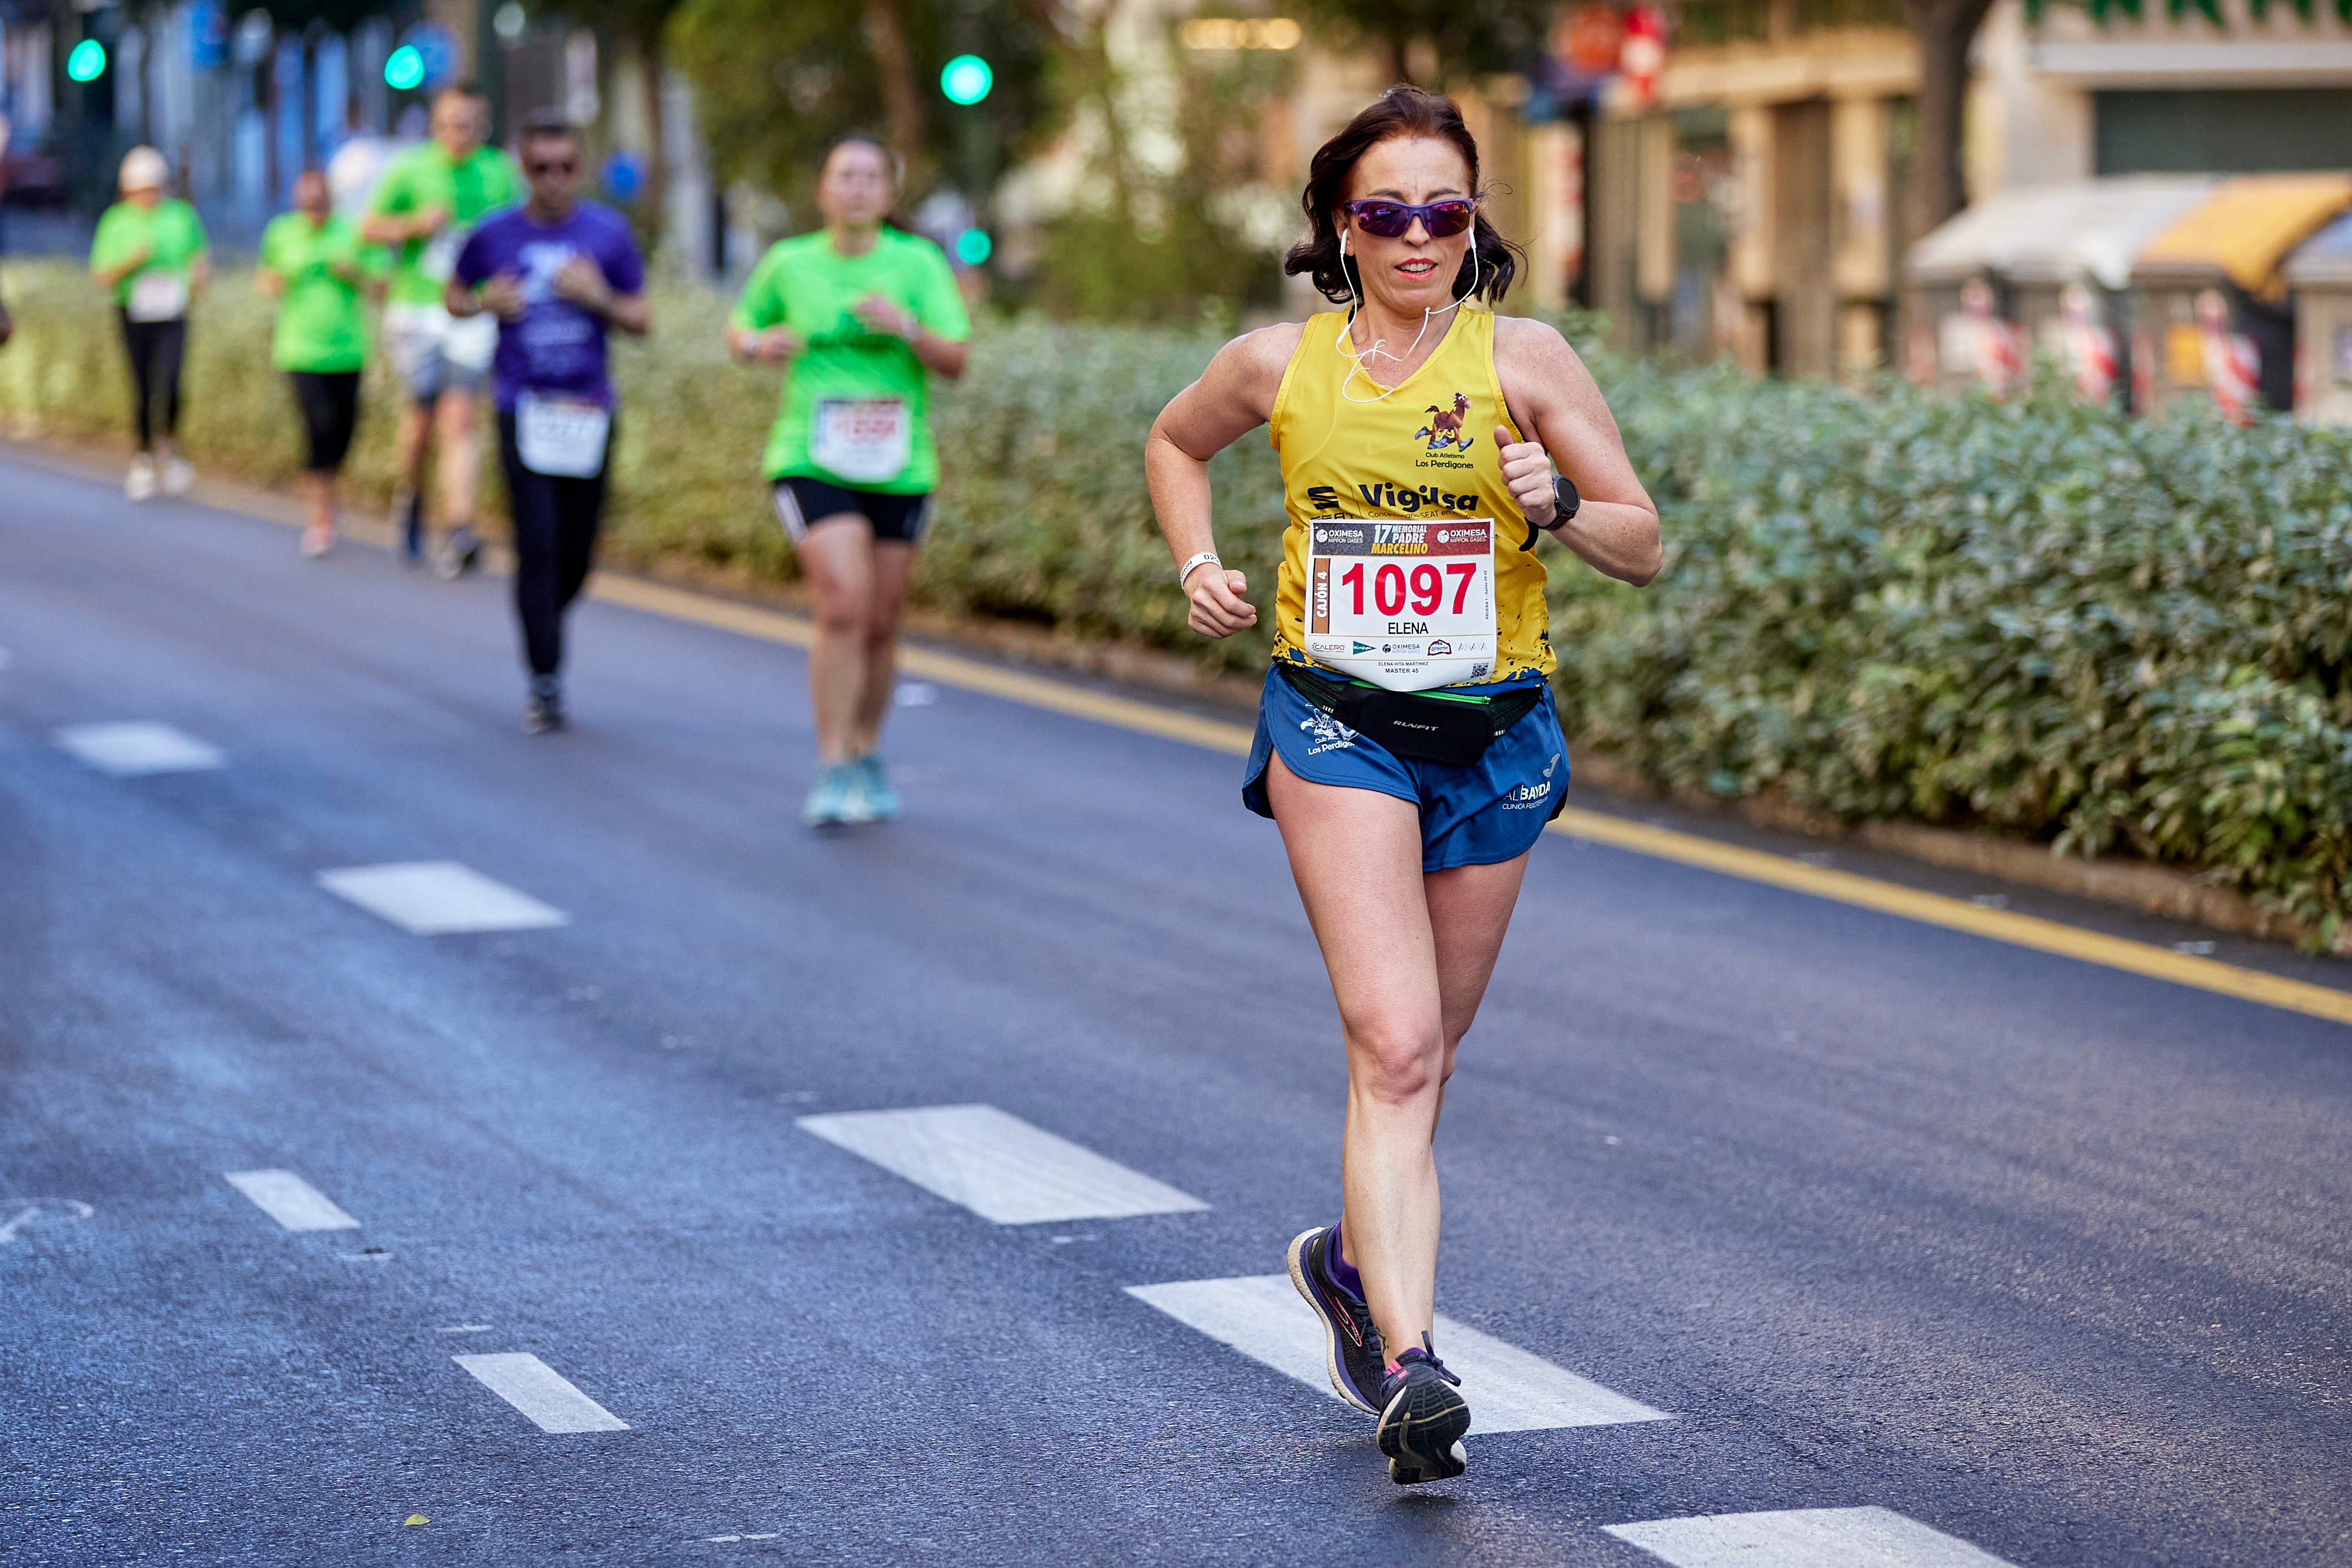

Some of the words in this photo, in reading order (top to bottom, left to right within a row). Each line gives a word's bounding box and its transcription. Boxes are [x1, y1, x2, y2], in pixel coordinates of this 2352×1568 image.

[1431, 460, 1474, 469] Perdigones
[1358, 482, 1479, 512] Vigilsa
[1420, 510, 1439, 519] SEAT
[1374, 524, 1393, 543] 17
[1391, 524, 1428, 533] MEMORIAL
[1392, 533, 1425, 544] PADRE
[1450, 529, 1486, 537] OXIMESA
[1371, 543, 1428, 554] MARCELINO
[1317, 571, 1328, 580] 4
[1342, 563, 1477, 616] 1097
[1314, 583, 1328, 618] CAJÓN
[1388, 622, 1429, 635] ELENA
[1458, 643, 1488, 651] ANAYA
[1392, 720, 1439, 731] RUNFIT
[1307, 747, 1321, 755] Los
[1321, 740, 1355, 752] Perdigo
